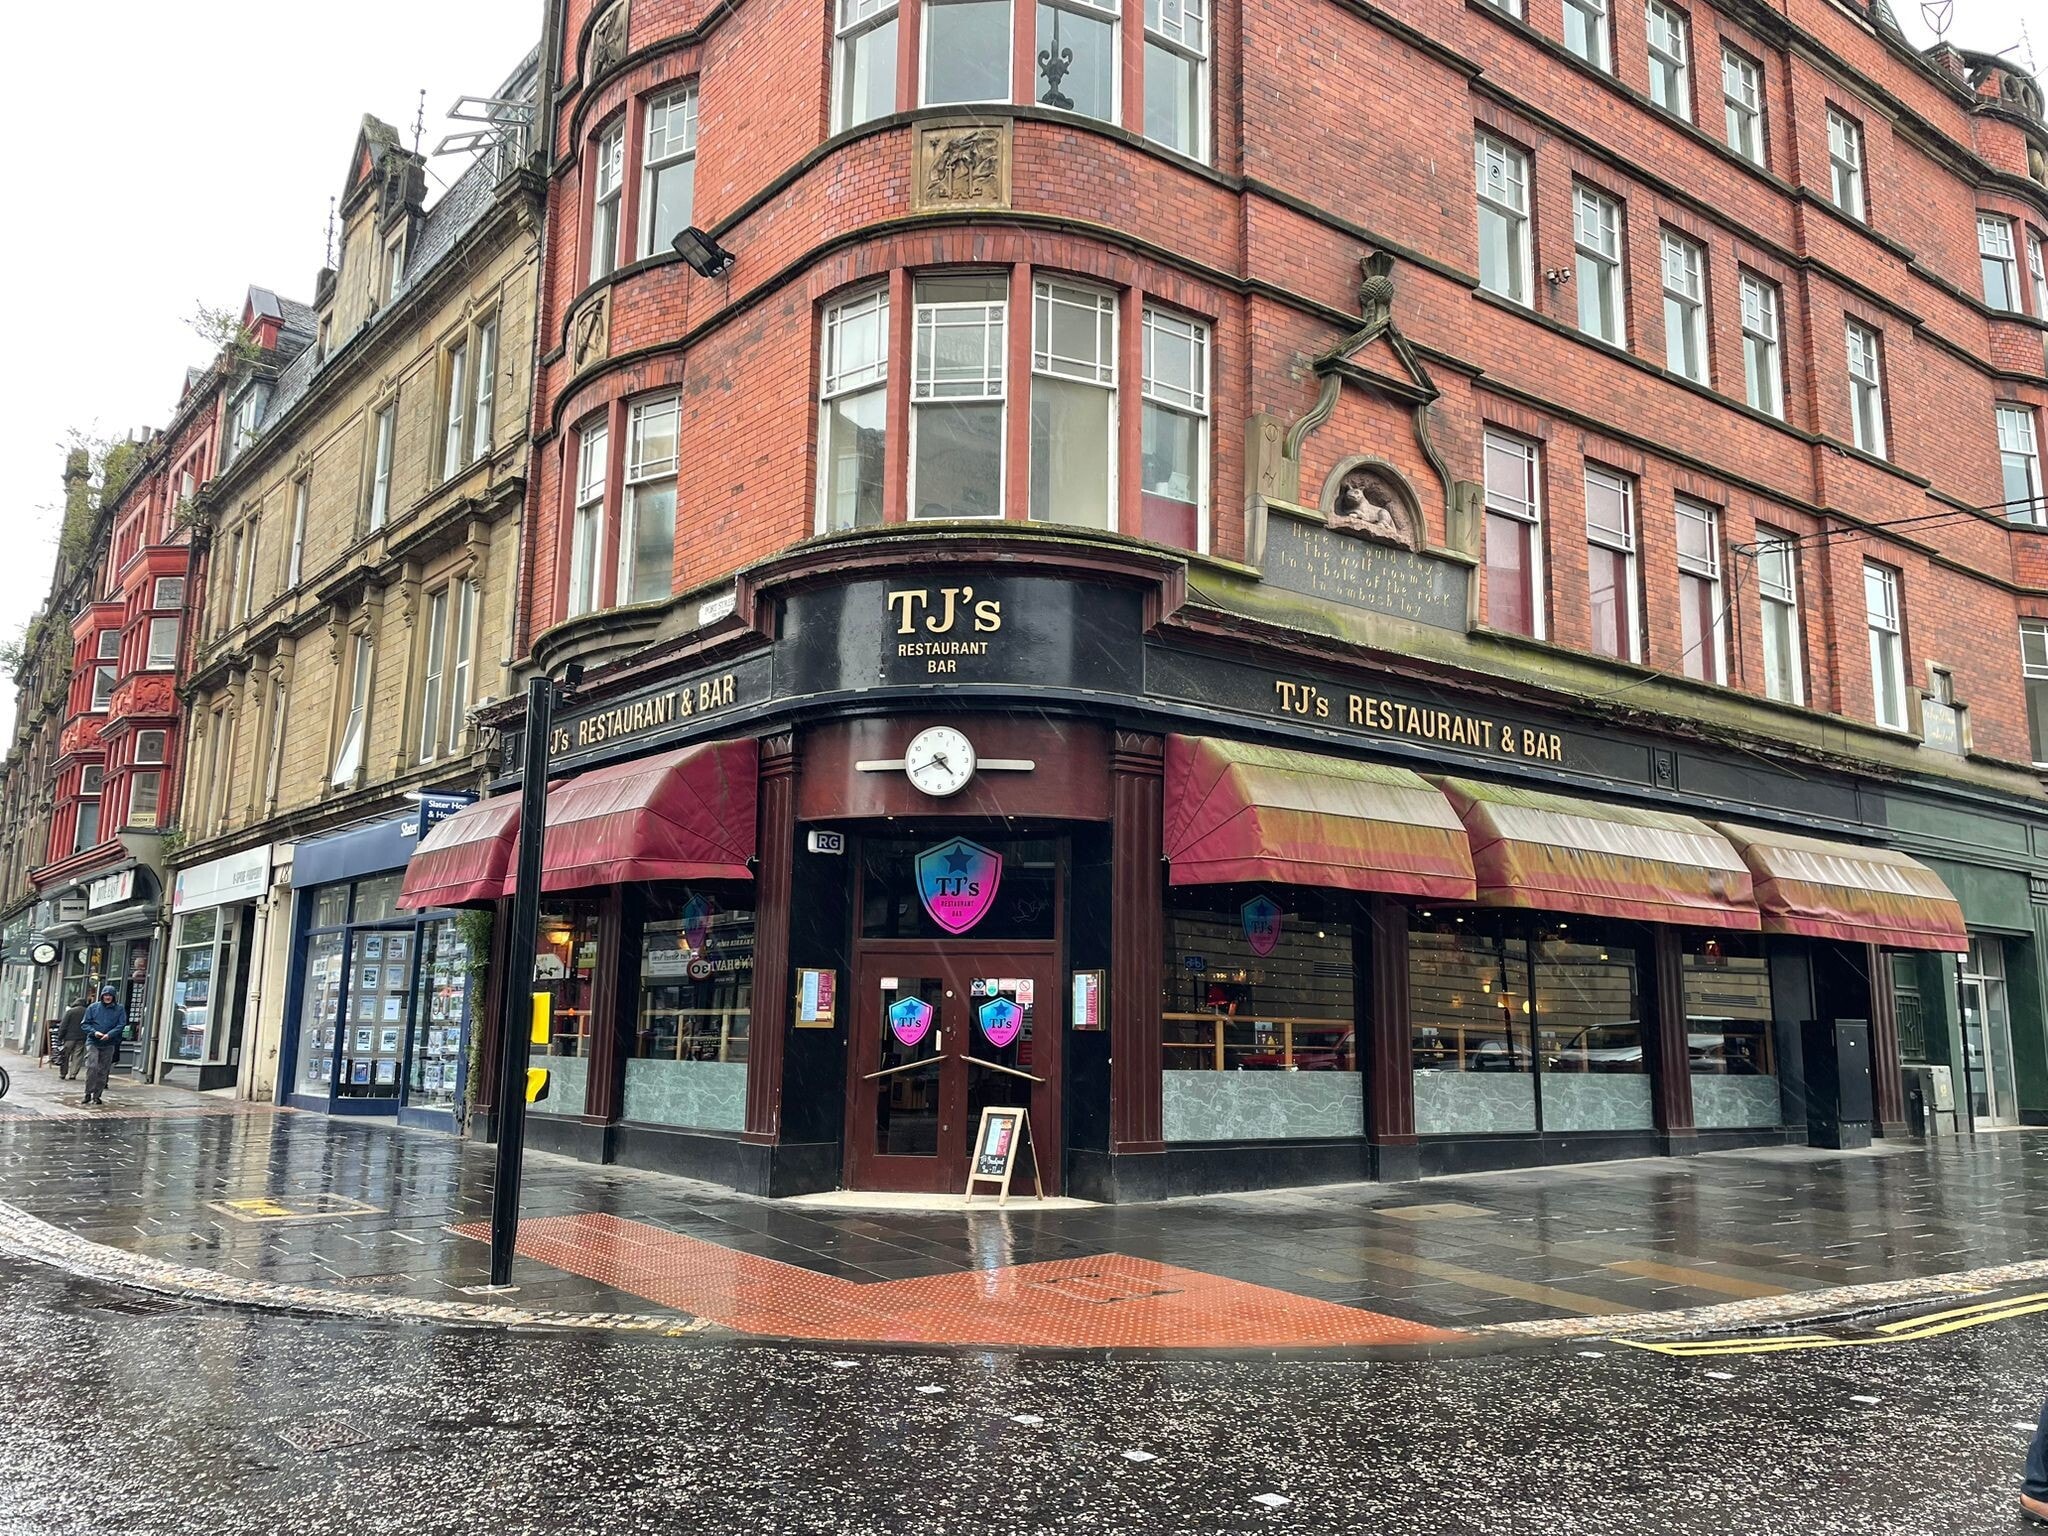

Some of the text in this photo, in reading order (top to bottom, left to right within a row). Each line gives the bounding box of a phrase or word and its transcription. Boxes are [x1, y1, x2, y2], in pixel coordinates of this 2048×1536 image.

[1293, 522, 1329, 545] Here
[1340, 541, 1355, 552] in
[1304, 541, 1330, 561] The
[1341, 556, 1373, 572] wolf
[1281, 550, 1297, 568] In
[1323, 562, 1356, 583] hole
[1365, 575, 1380, 589] of
[1387, 579, 1407, 597] the
[1312, 574, 1422, 617] In ambush lay
[887, 585, 1002, 634] TJ's
[898, 642, 988, 657] RESTAURANT
[927, 659, 957, 673] BAR
[550, 673, 734, 755] J's RESTAURANT & BAR
[1275, 680, 1563, 761] TJ's RESTAURANT & BAR
[427, 810, 435, 818] &
[428, 800, 451, 809] Slater
[818, 834, 839, 849] RG
[935, 876, 980, 897] TJ's
[900, 1016, 922, 1028] TJ's
[989, 1017, 1013, 1029] TJ's
